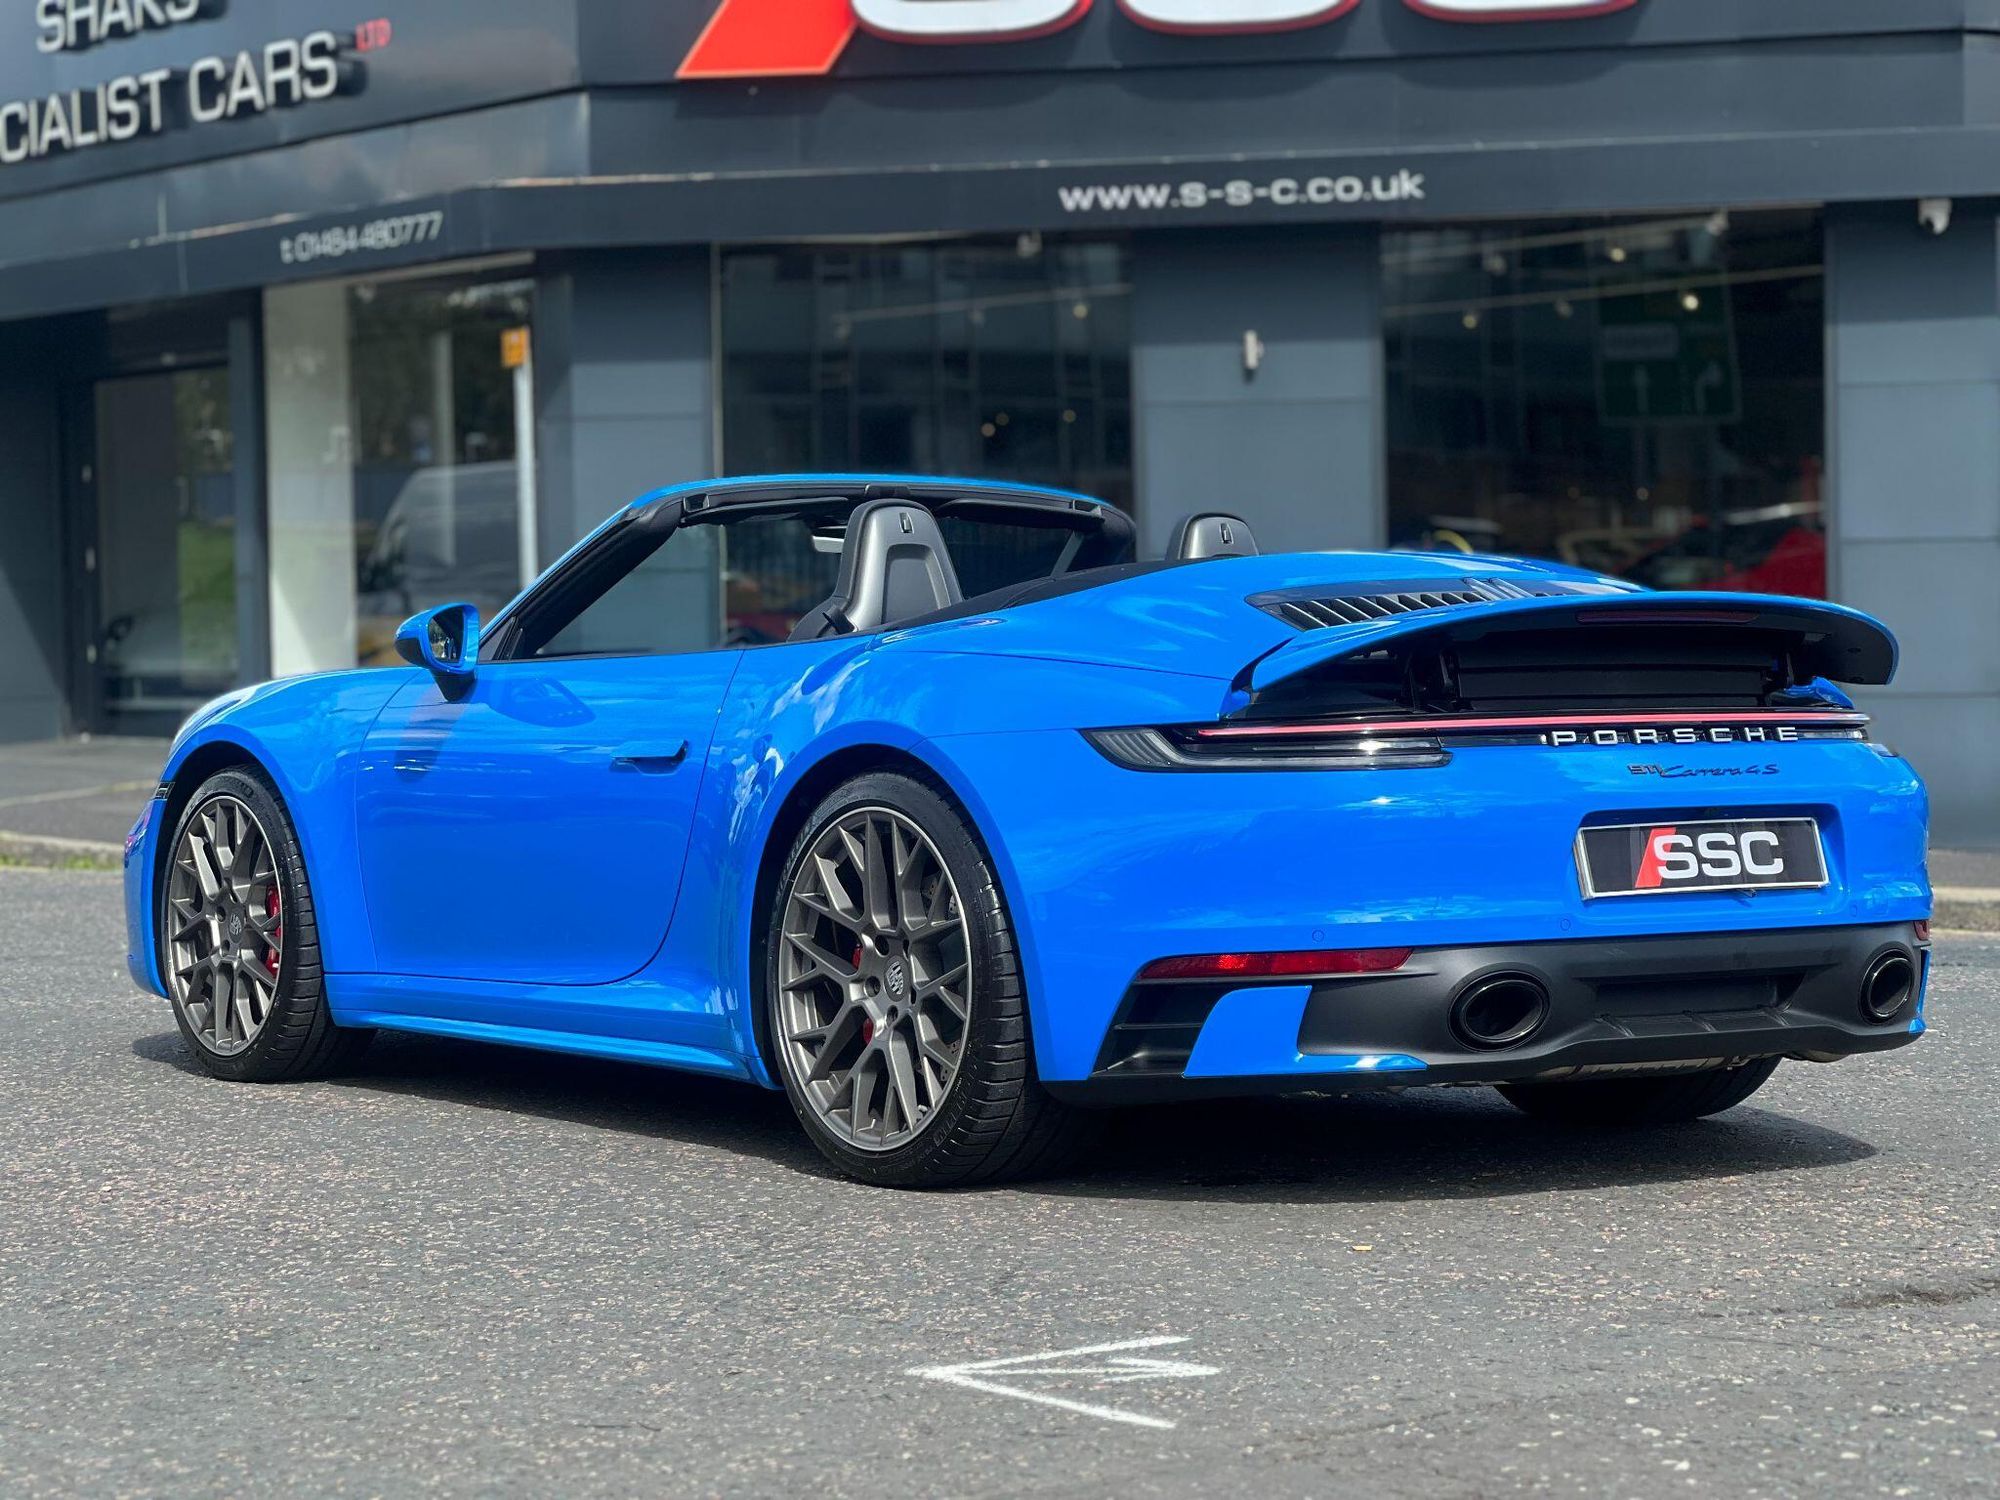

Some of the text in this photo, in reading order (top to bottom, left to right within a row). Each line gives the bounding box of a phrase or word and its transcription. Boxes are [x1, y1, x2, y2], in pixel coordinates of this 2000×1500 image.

[188, 31, 339, 122] CARS
[355, 18, 392, 51] LTD
[1058, 168, 1425, 212] www.s-s-c.co.uk
[1551, 726, 1799, 746] PORSCHE
[1627, 763, 1664, 776] 911
[1661, 764, 1743, 778] Carrera
[1653, 830, 1784, 880] SSC
